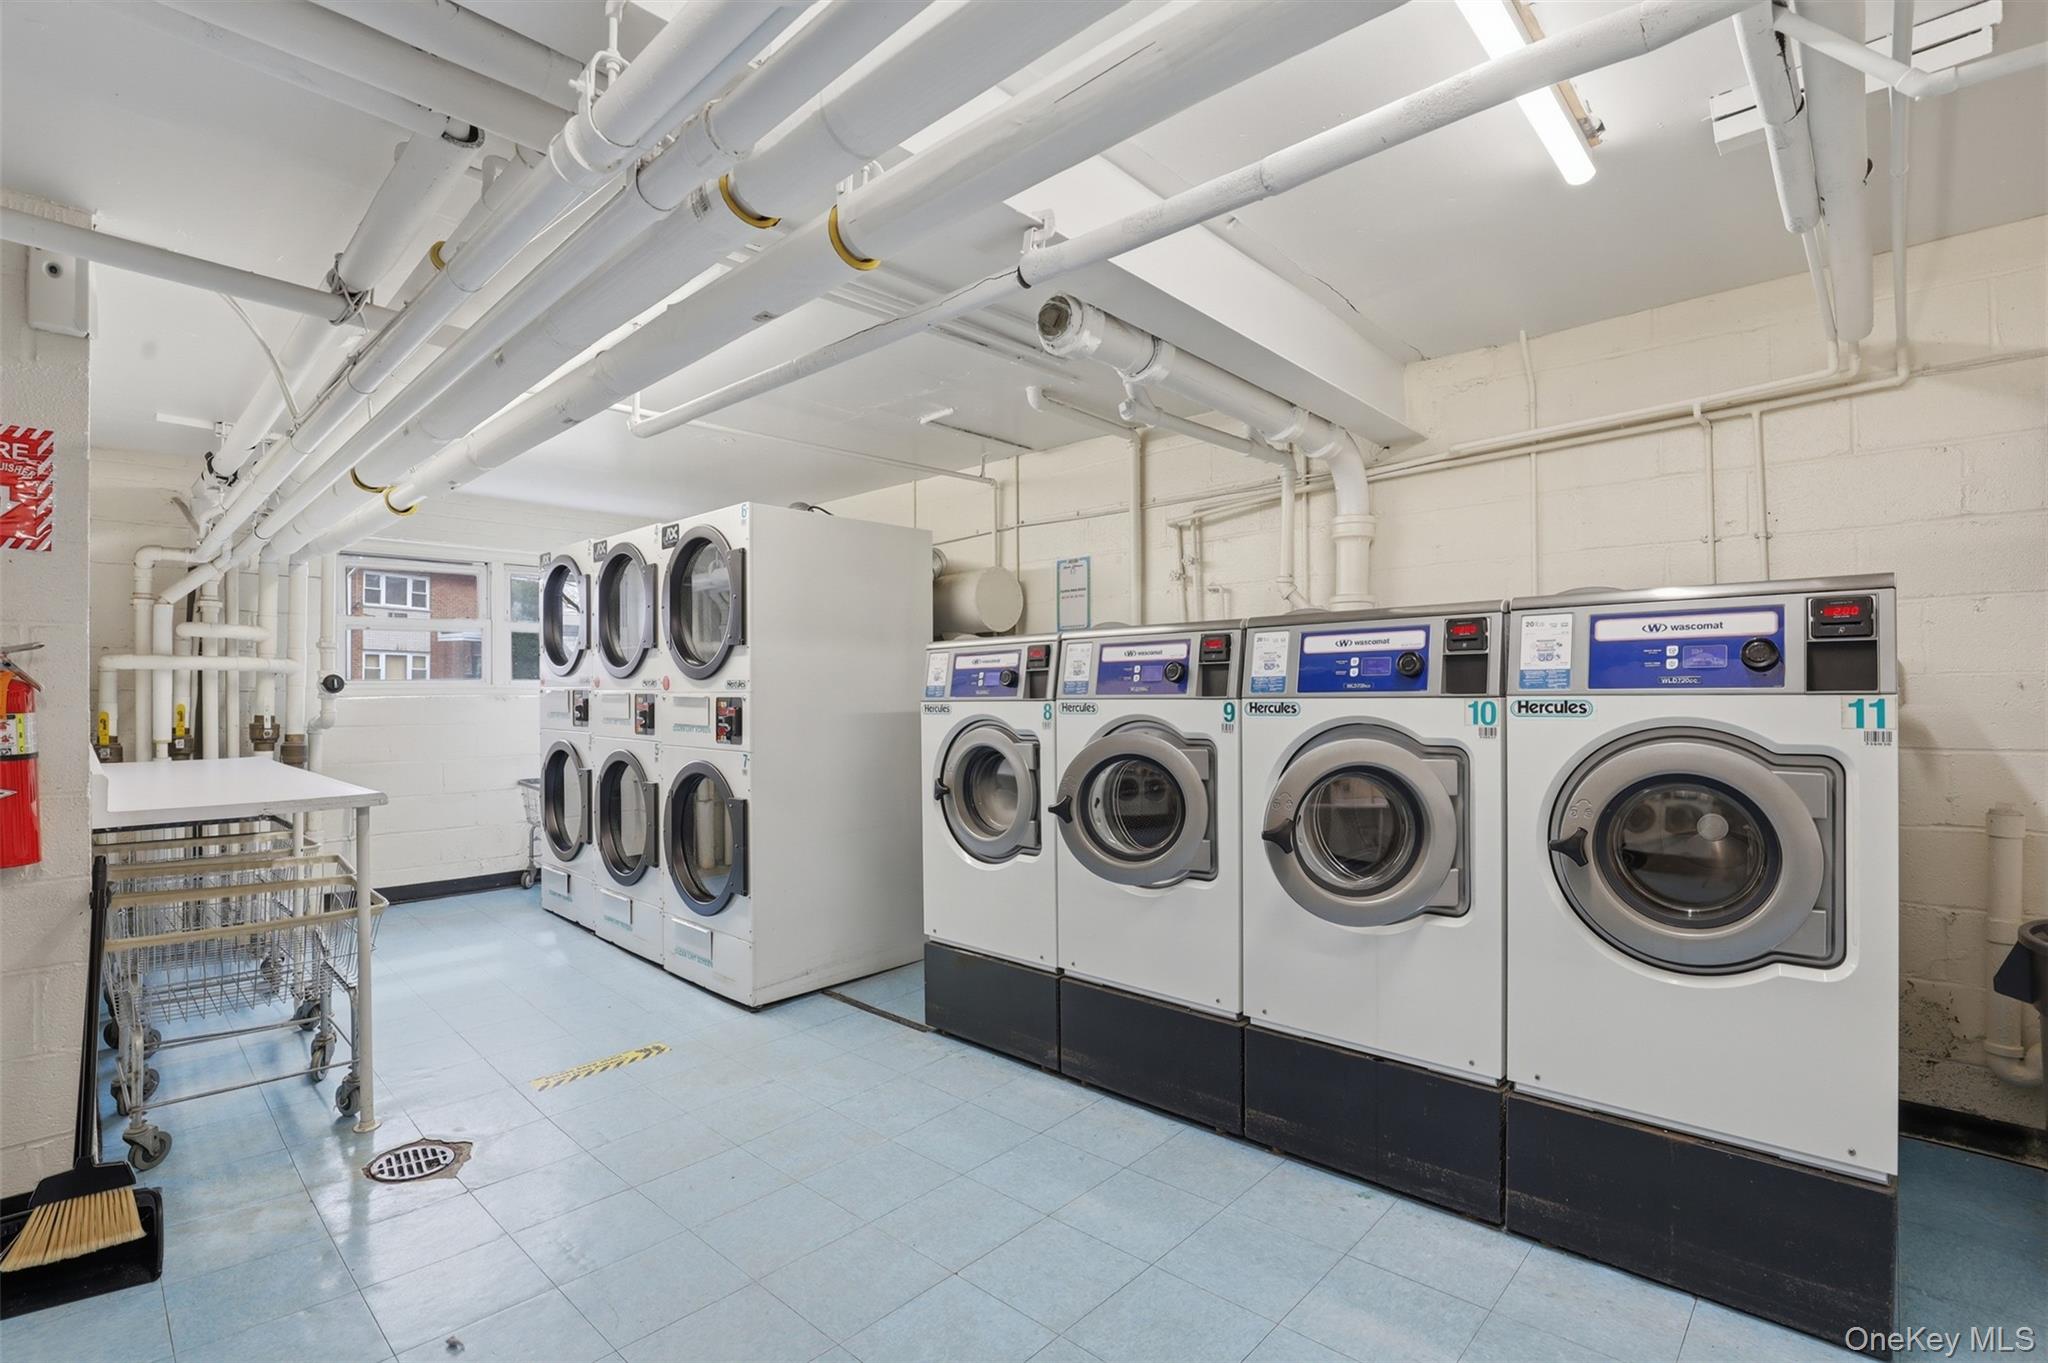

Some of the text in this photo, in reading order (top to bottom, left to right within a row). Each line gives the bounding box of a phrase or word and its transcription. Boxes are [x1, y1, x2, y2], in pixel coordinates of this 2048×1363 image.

[741, 504, 747, 518] 6
[1670, 622, 1724, 632] wascomat
[1354, 638, 1391, 646] wascomat
[924, 704, 950, 713] Hercules
[1043, 703, 1052, 721] 8
[1061, 703, 1096, 713] Hercules
[1223, 702, 1236, 723] 9
[1249, 702, 1297, 714] Hercules
[1467, 700, 1497, 726] 10
[1517, 700, 1588, 714] Hercules
[1848, 698, 1886, 729] 11
[742, 754, 748, 768] 7
